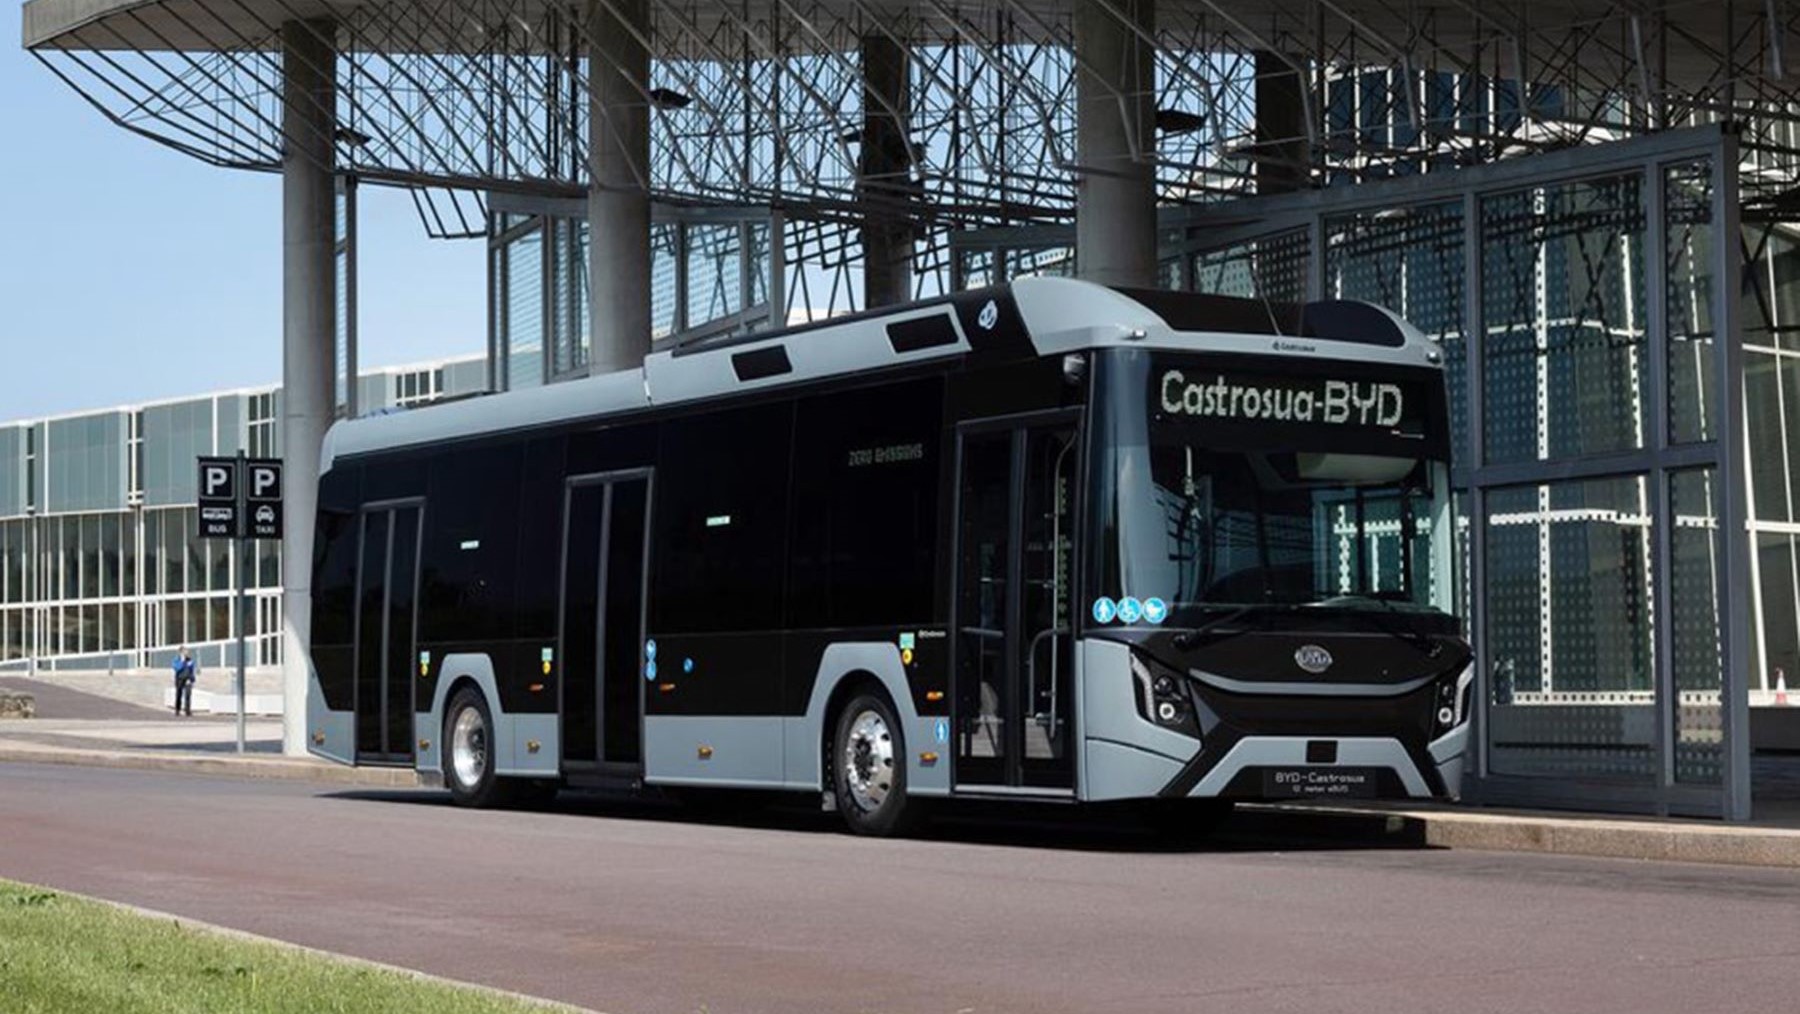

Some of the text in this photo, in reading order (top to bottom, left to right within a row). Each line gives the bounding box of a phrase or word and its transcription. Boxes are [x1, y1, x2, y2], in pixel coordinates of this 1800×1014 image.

[1161, 369, 1403, 427] Castrosua-BYD
[207, 467, 227, 495] P
[255, 468, 275, 496] P
[208, 524, 227, 533] BUS
